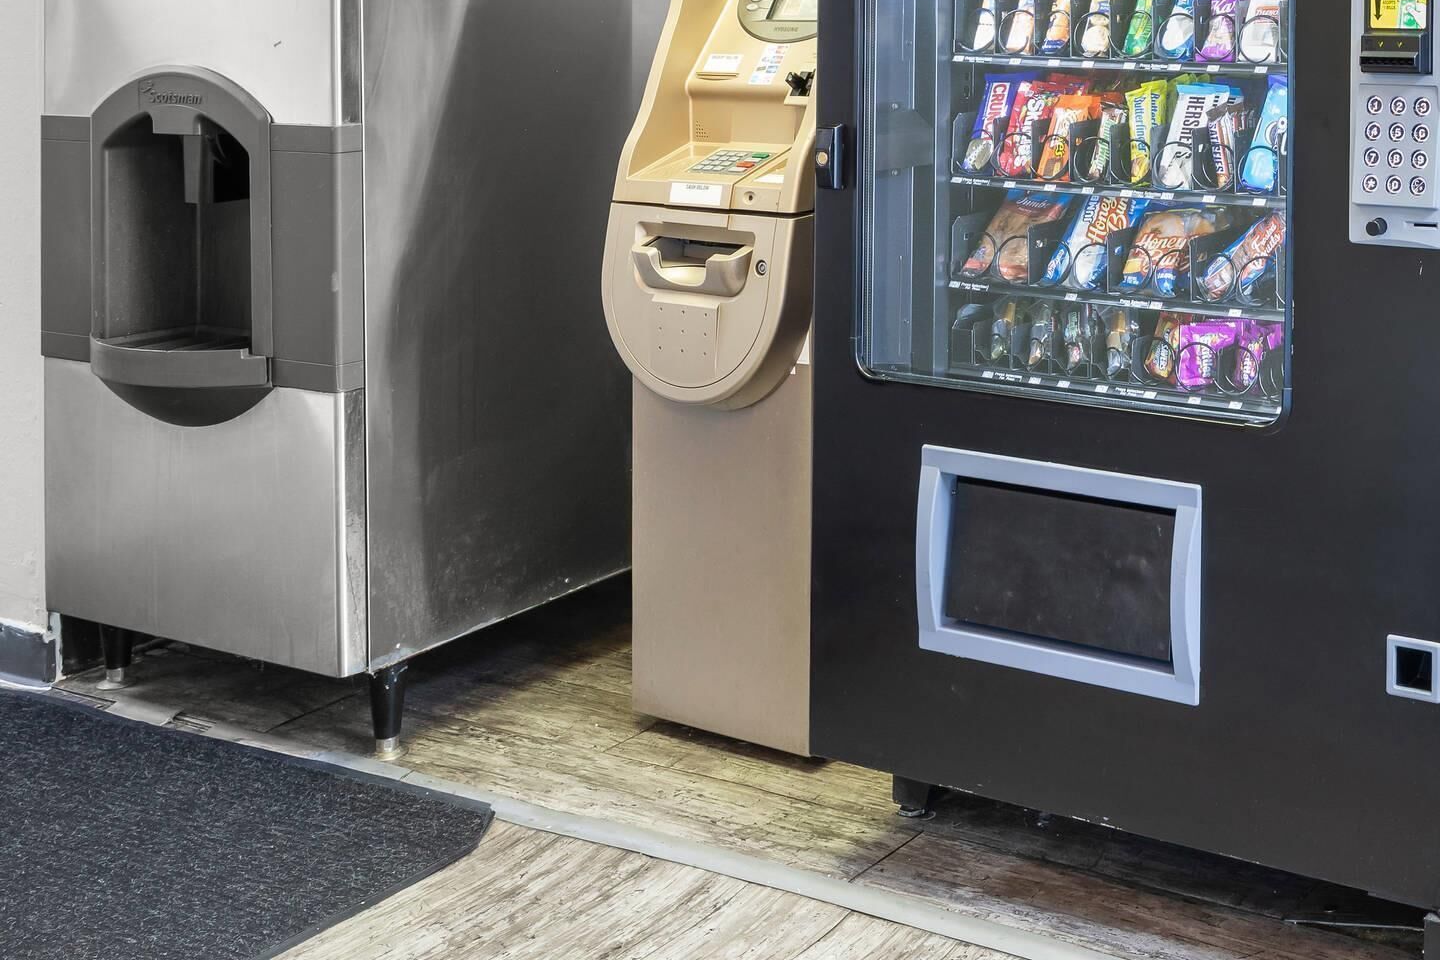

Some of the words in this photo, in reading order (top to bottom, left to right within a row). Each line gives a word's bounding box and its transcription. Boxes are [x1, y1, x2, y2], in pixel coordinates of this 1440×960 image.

[149, 91, 203, 106] Scotsman
[1133, 96, 1148, 153] Butterfinger
[1083, 195, 1100, 223] JUMB
[1086, 197, 1118, 245] Honey
[1106, 197, 1130, 233] Bun
[1136, 232, 1188, 250] Honey
